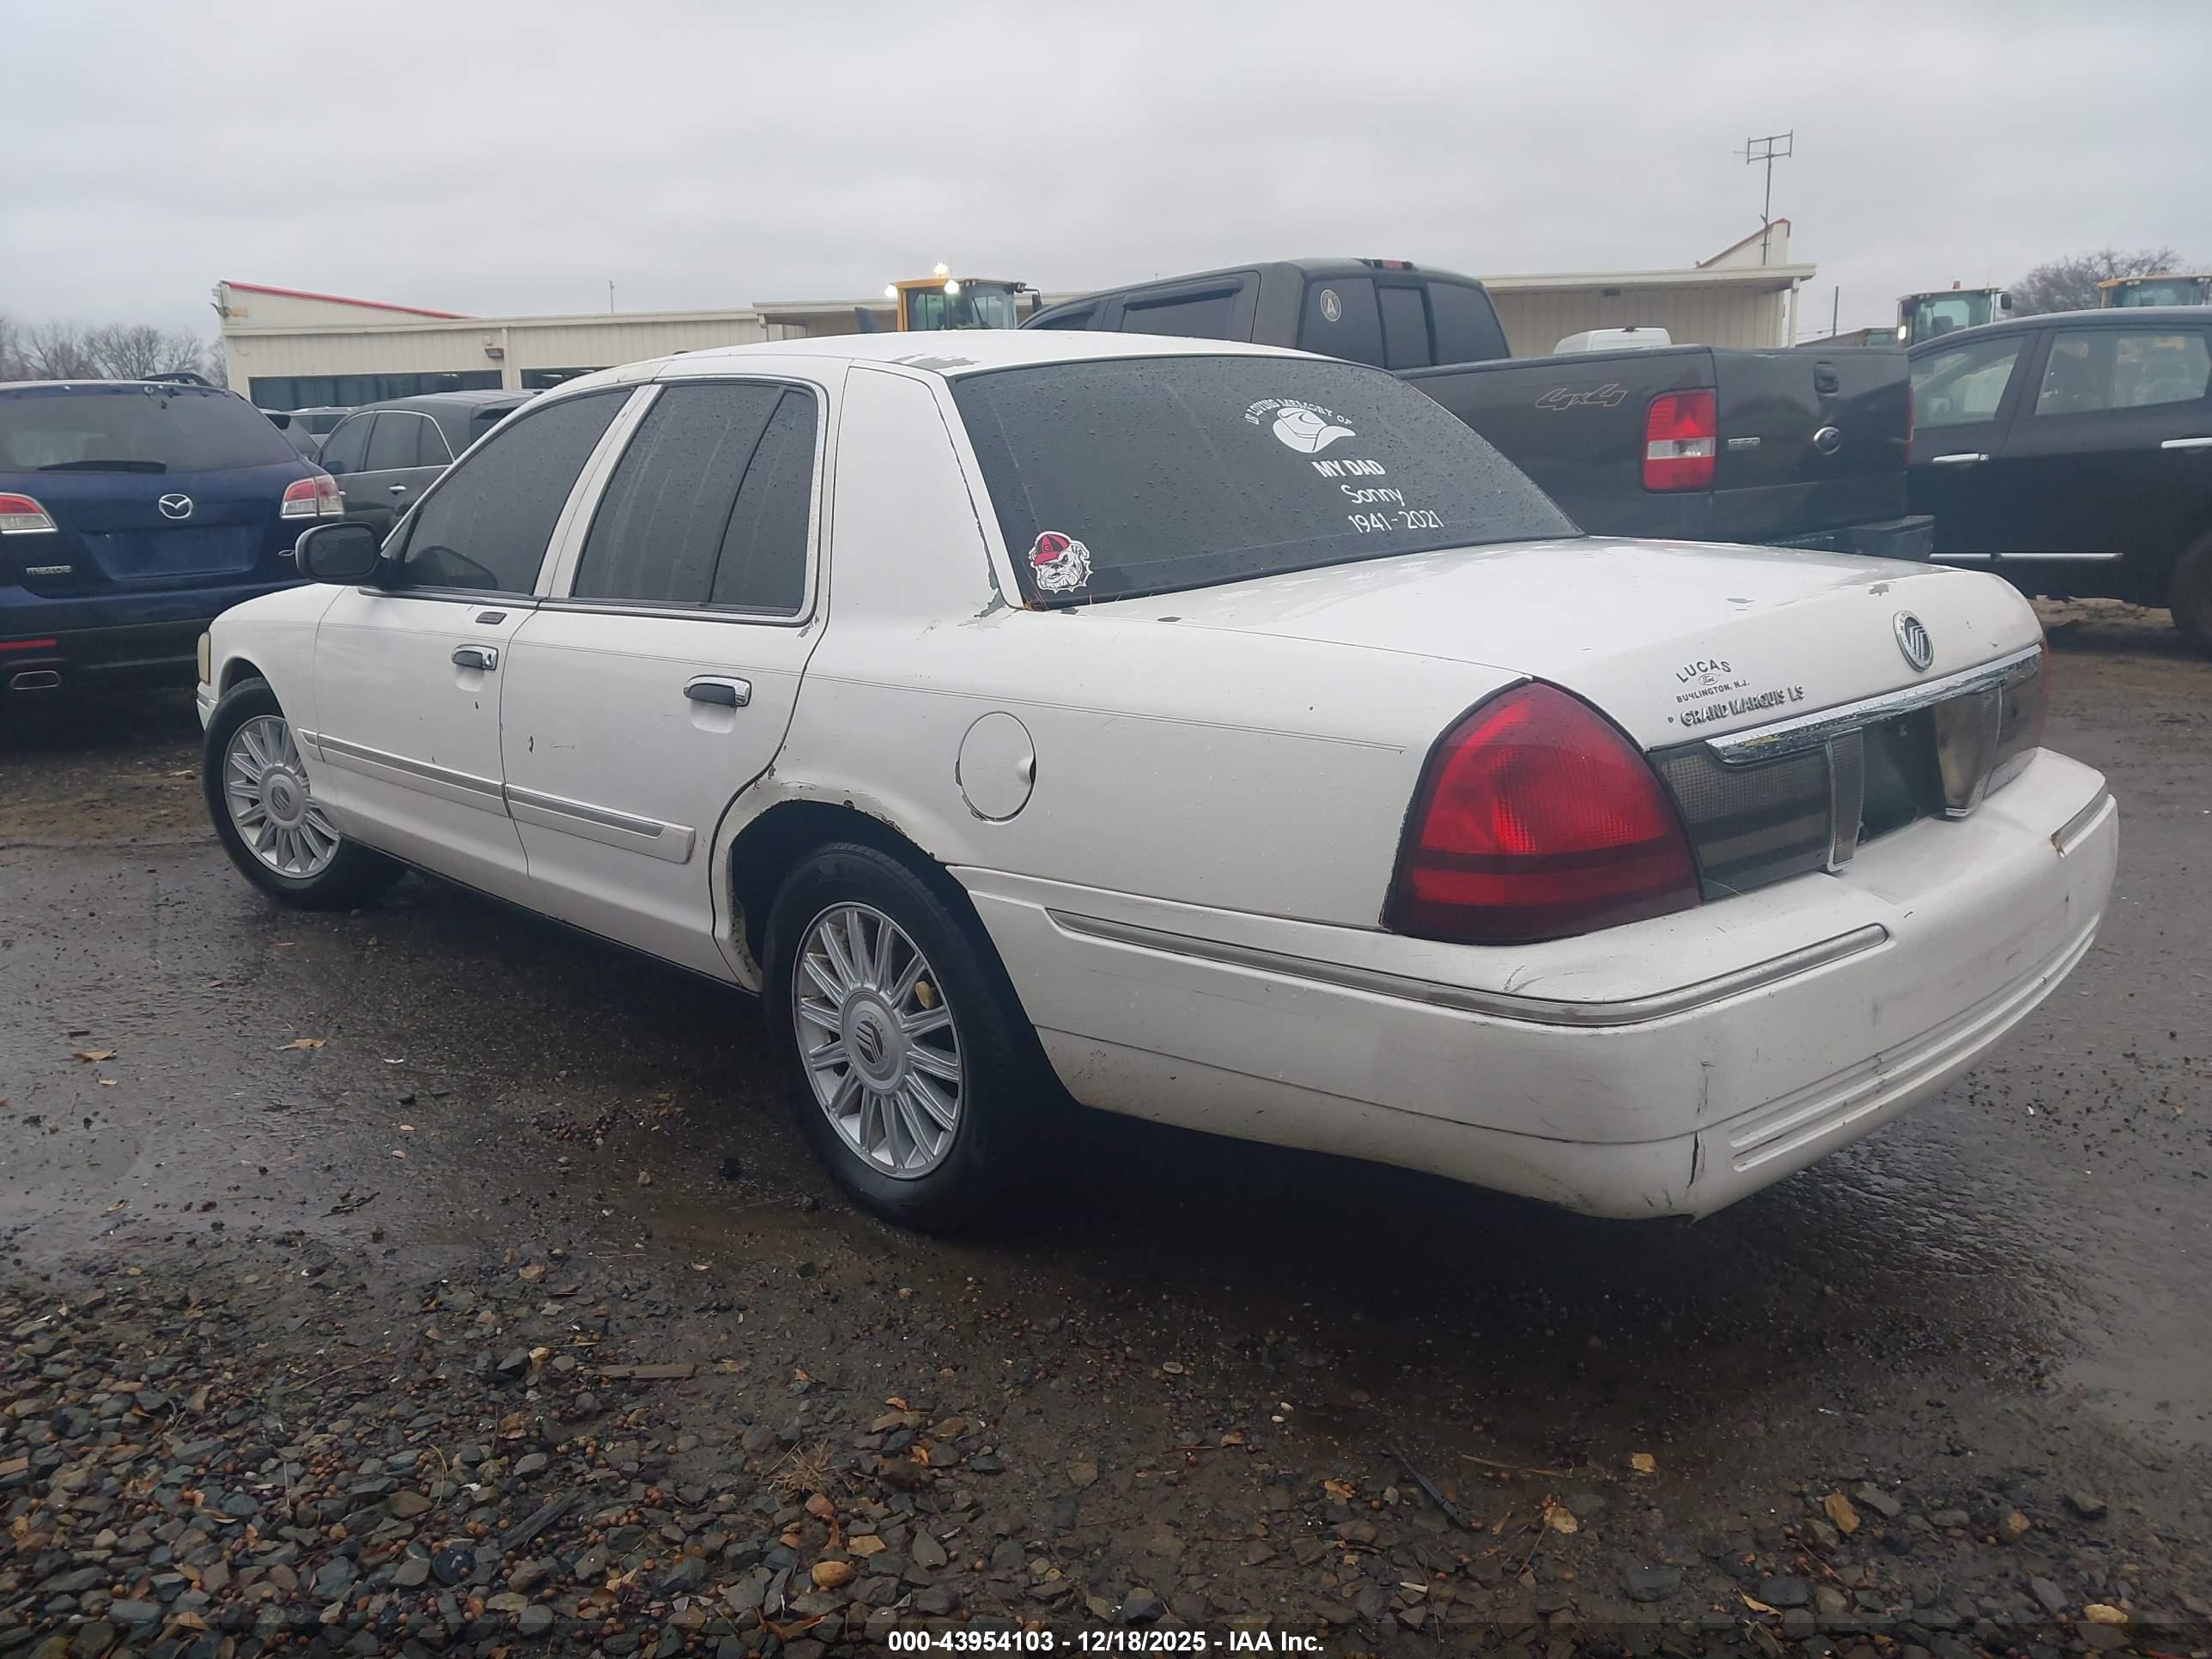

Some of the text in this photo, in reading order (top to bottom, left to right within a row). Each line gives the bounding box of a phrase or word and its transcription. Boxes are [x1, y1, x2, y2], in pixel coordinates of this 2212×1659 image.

[1535, 383, 1628, 410] 4x4
[1336, 415, 1353, 425] OF
[1311, 459, 1387, 477] MY DAD
[1340, 484, 1406, 507] Sonny
[1675, 659, 1733, 684] LUCAS
[1680, 685, 1805, 726] GRAND MARQUIS LS
